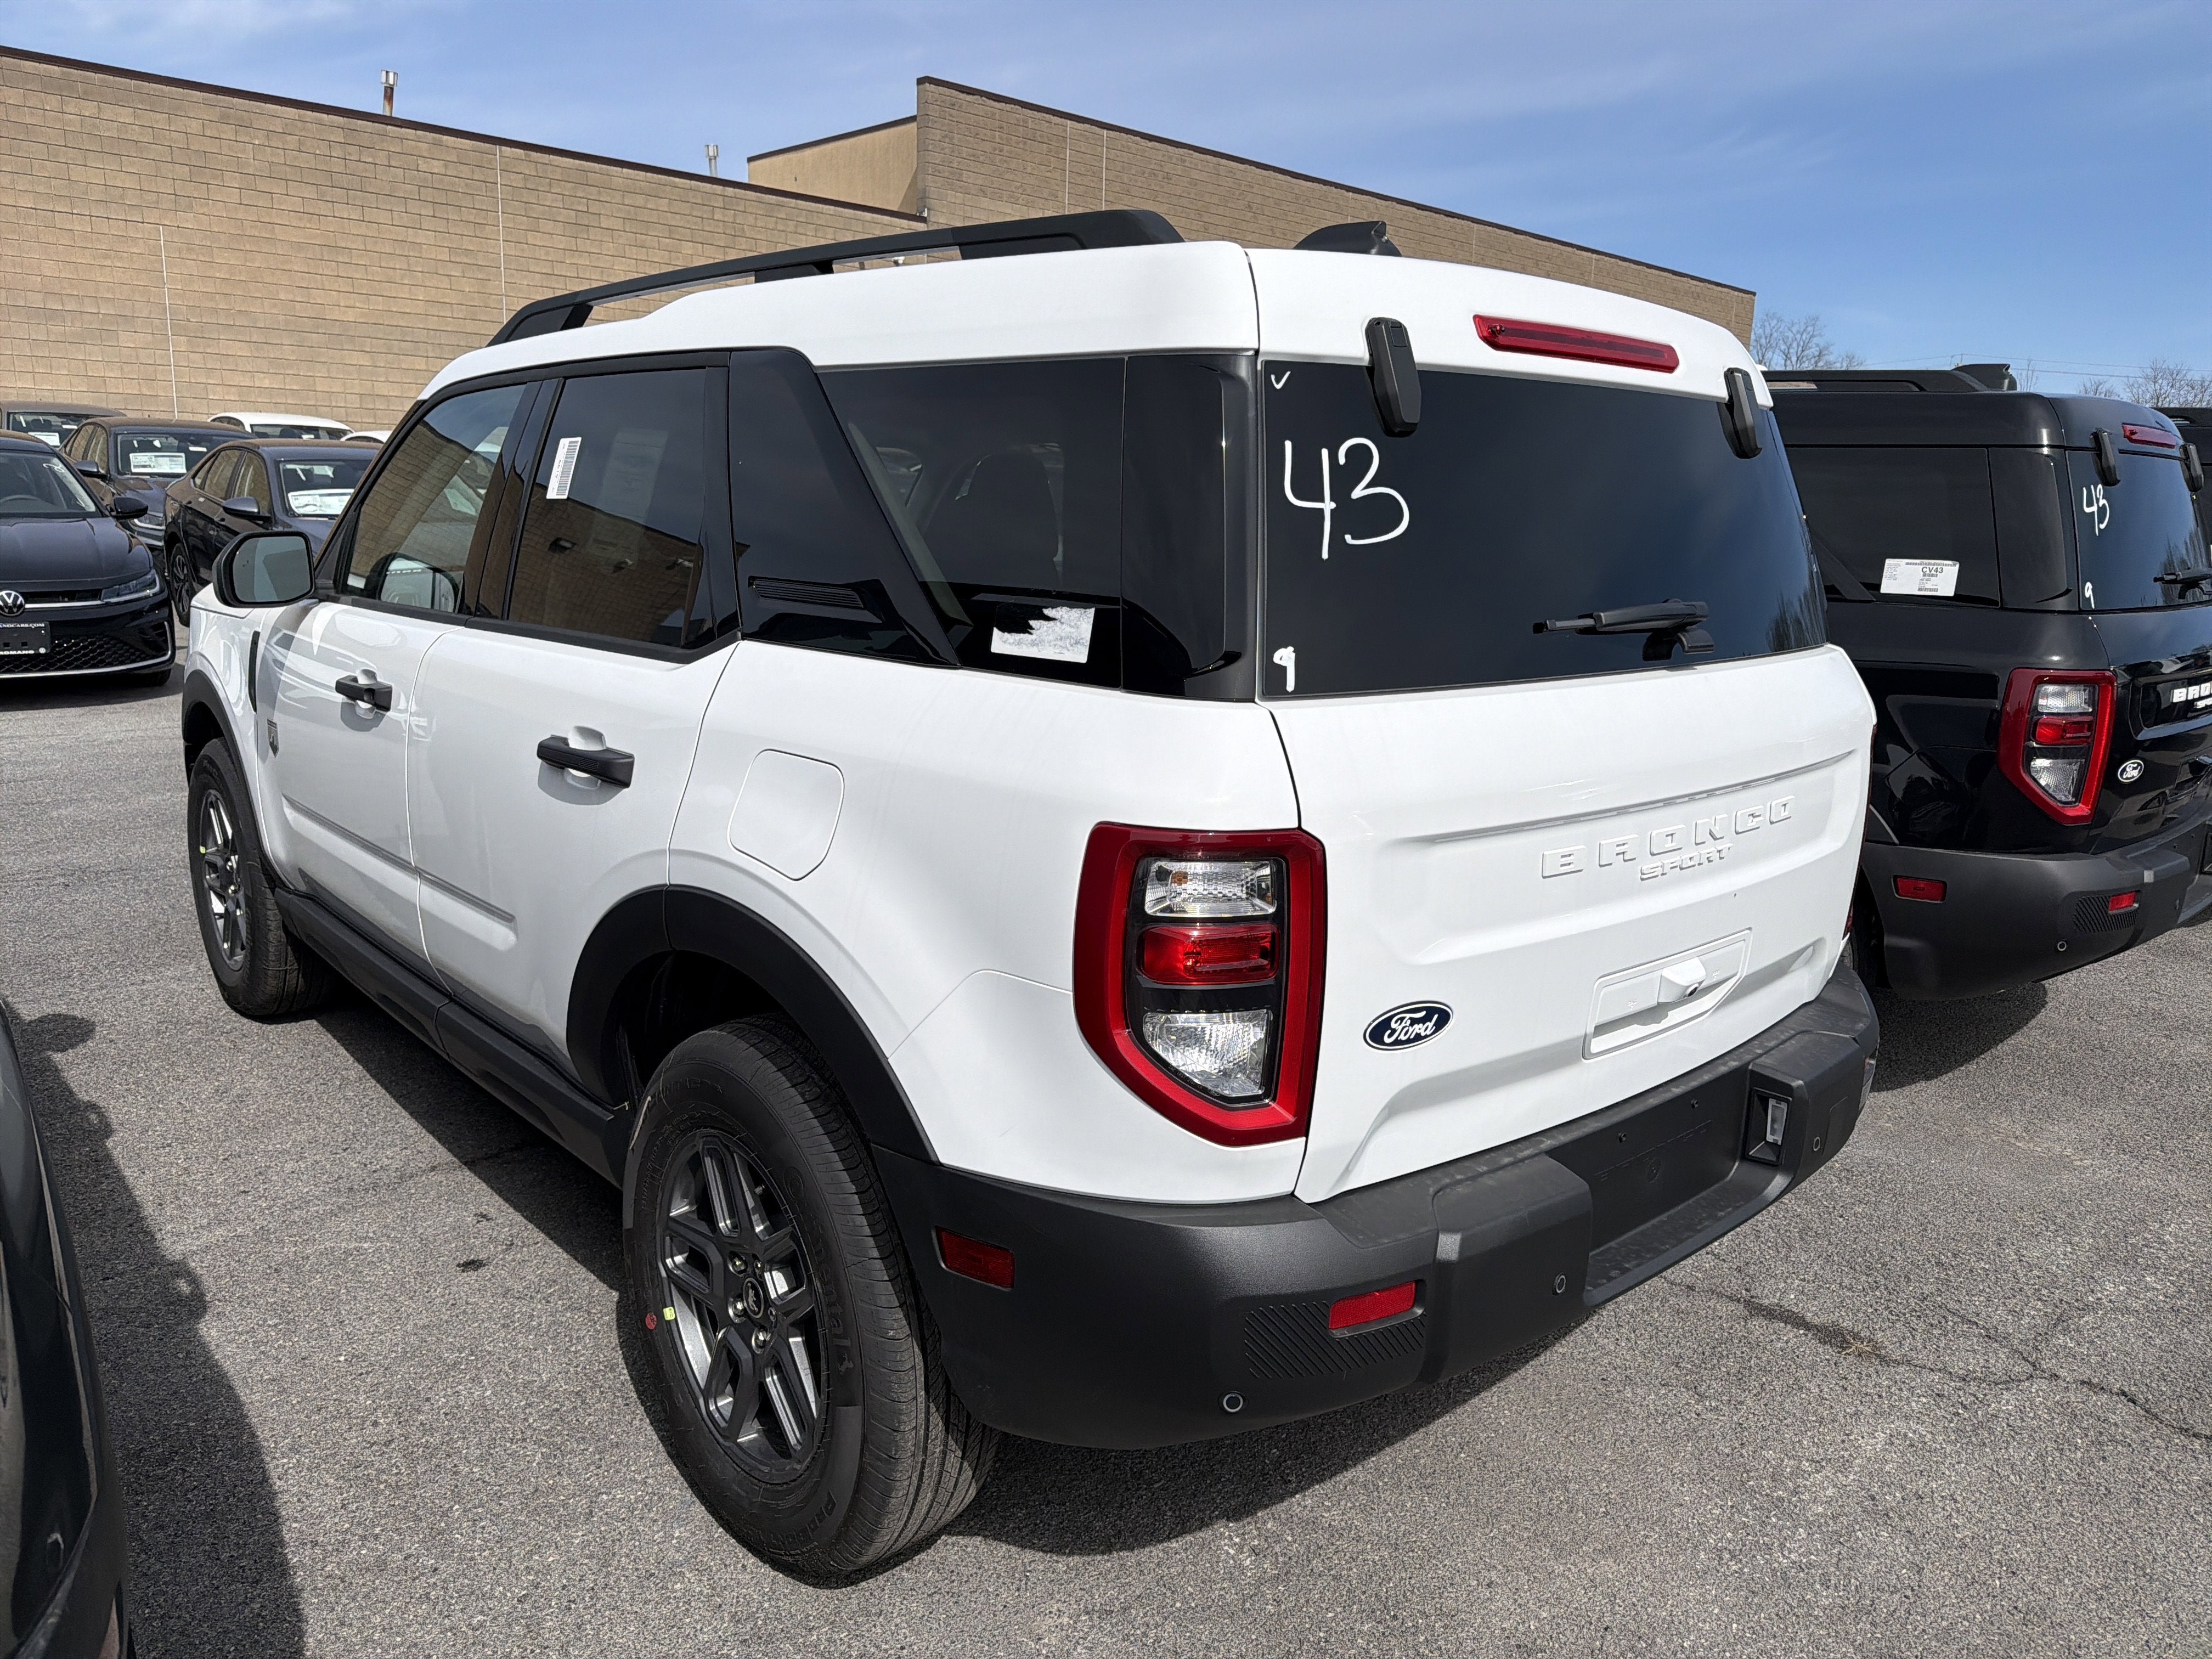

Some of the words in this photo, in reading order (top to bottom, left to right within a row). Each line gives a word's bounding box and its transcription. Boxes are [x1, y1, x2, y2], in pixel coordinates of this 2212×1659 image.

[1284, 437, 1409, 560] 43
[2083, 484, 2109, 537] 43
[2085, 582, 2095, 609] 9
[1273, 646, 1296, 692] 9
[2171, 681, 2212, 703] BRO
[2123, 764, 2141, 779] Ford
[1542, 795, 1793, 878] BRONCO
[1640, 843, 1734, 882] SPORT
[1384, 1011, 1438, 1043] Ford
[783, 1166, 851, 1347] Ctinental
